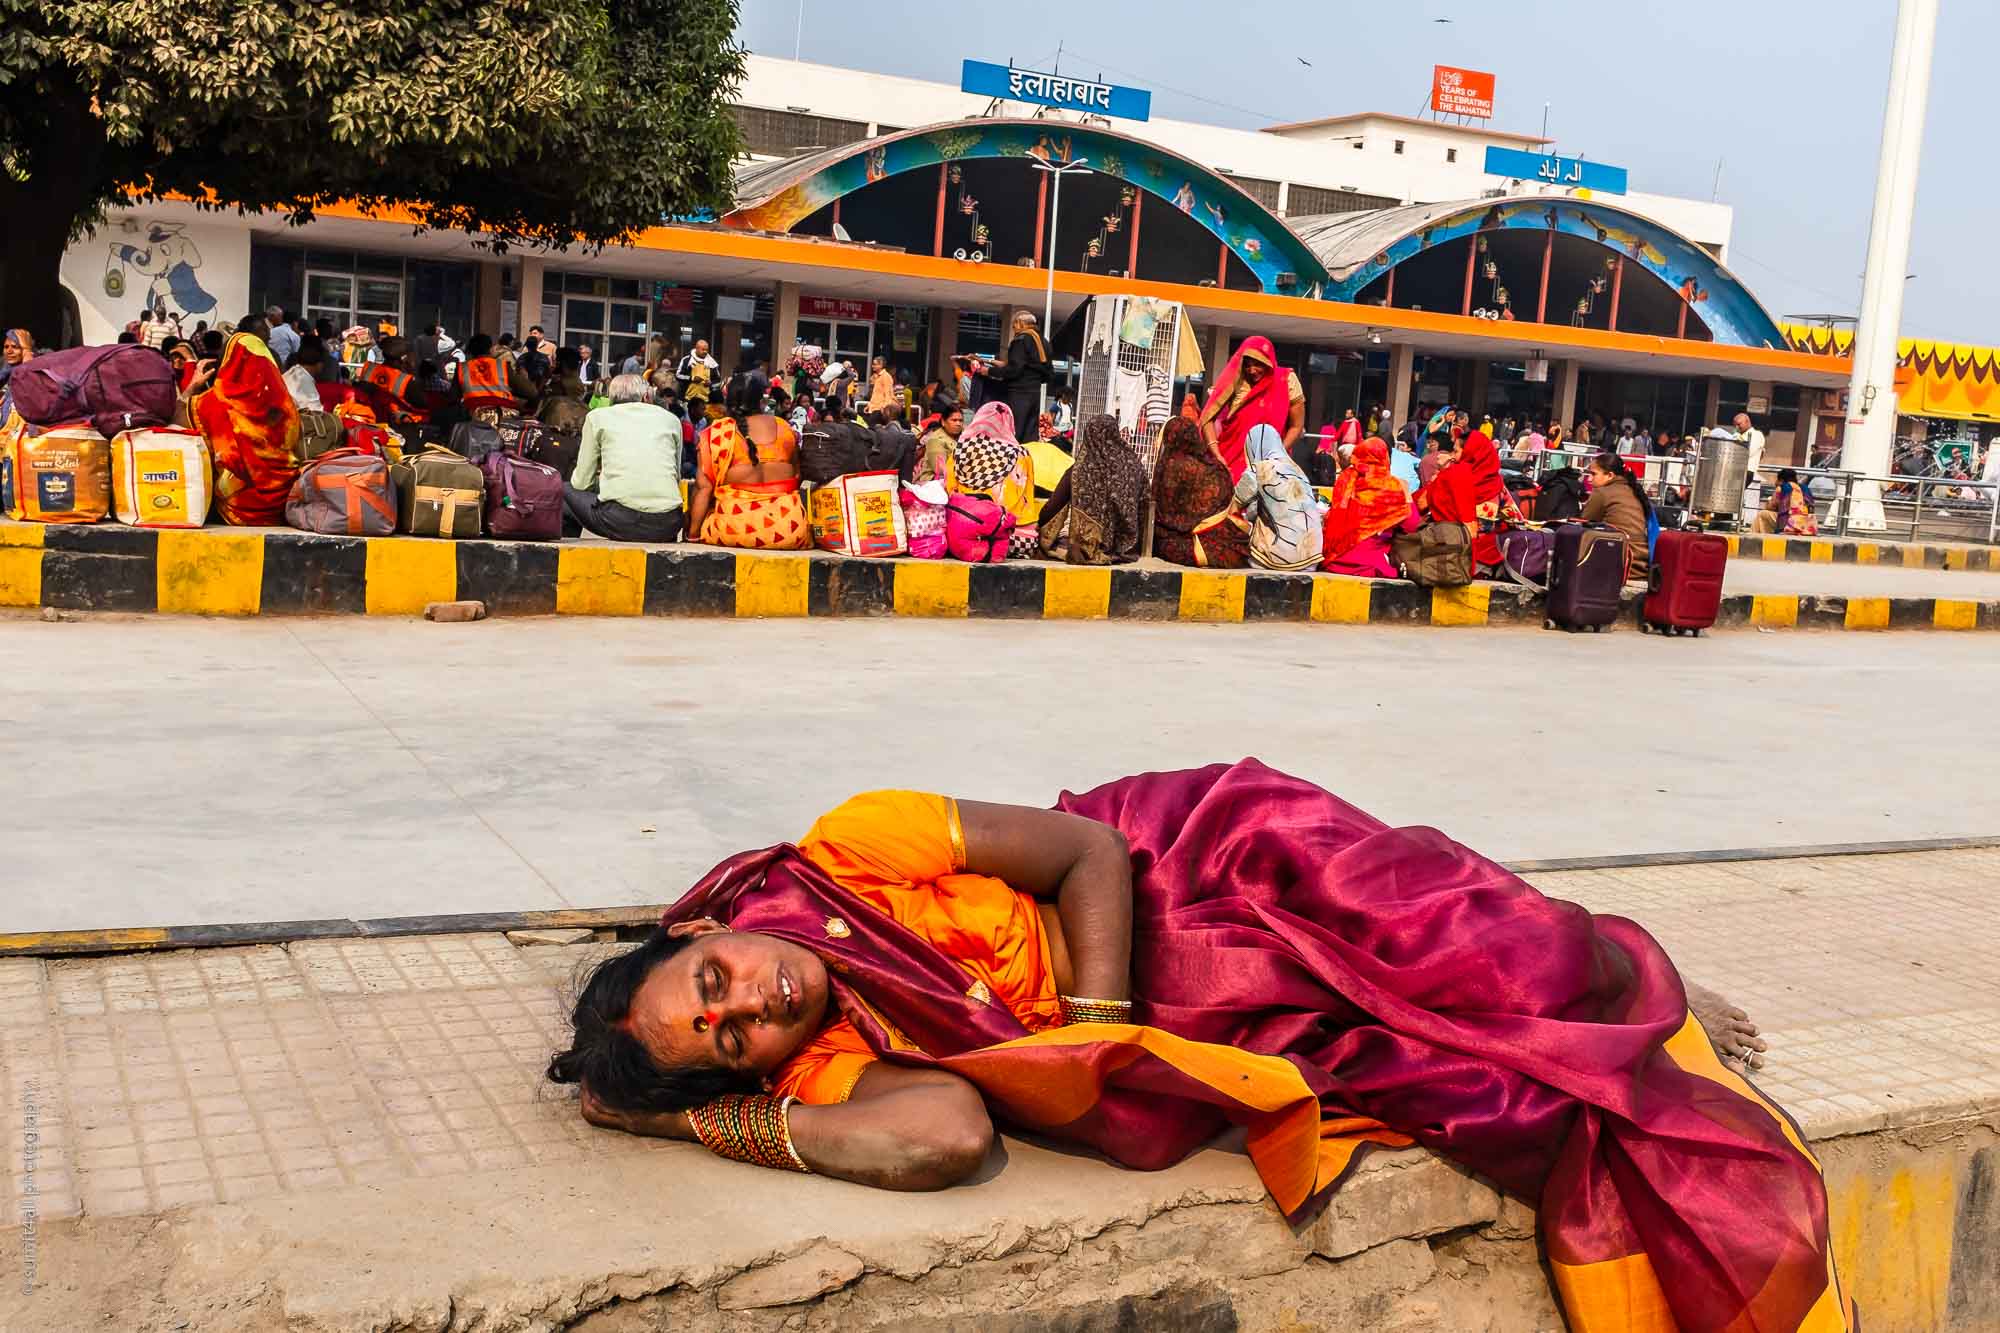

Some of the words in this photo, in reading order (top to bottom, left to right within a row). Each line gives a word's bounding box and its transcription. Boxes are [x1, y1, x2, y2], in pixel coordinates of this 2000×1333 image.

[1008, 68, 1112, 109] इलाहाबाद
[1440, 85, 1466, 97] YEARS
[1466, 87, 1478, 97] OF
[1440, 93, 1491, 108] CELEBRATING
[1440, 101, 1454, 111] THE
[1455, 103, 1491, 117] MAHATMA
[1538, 158, 1560, 182] آباد
